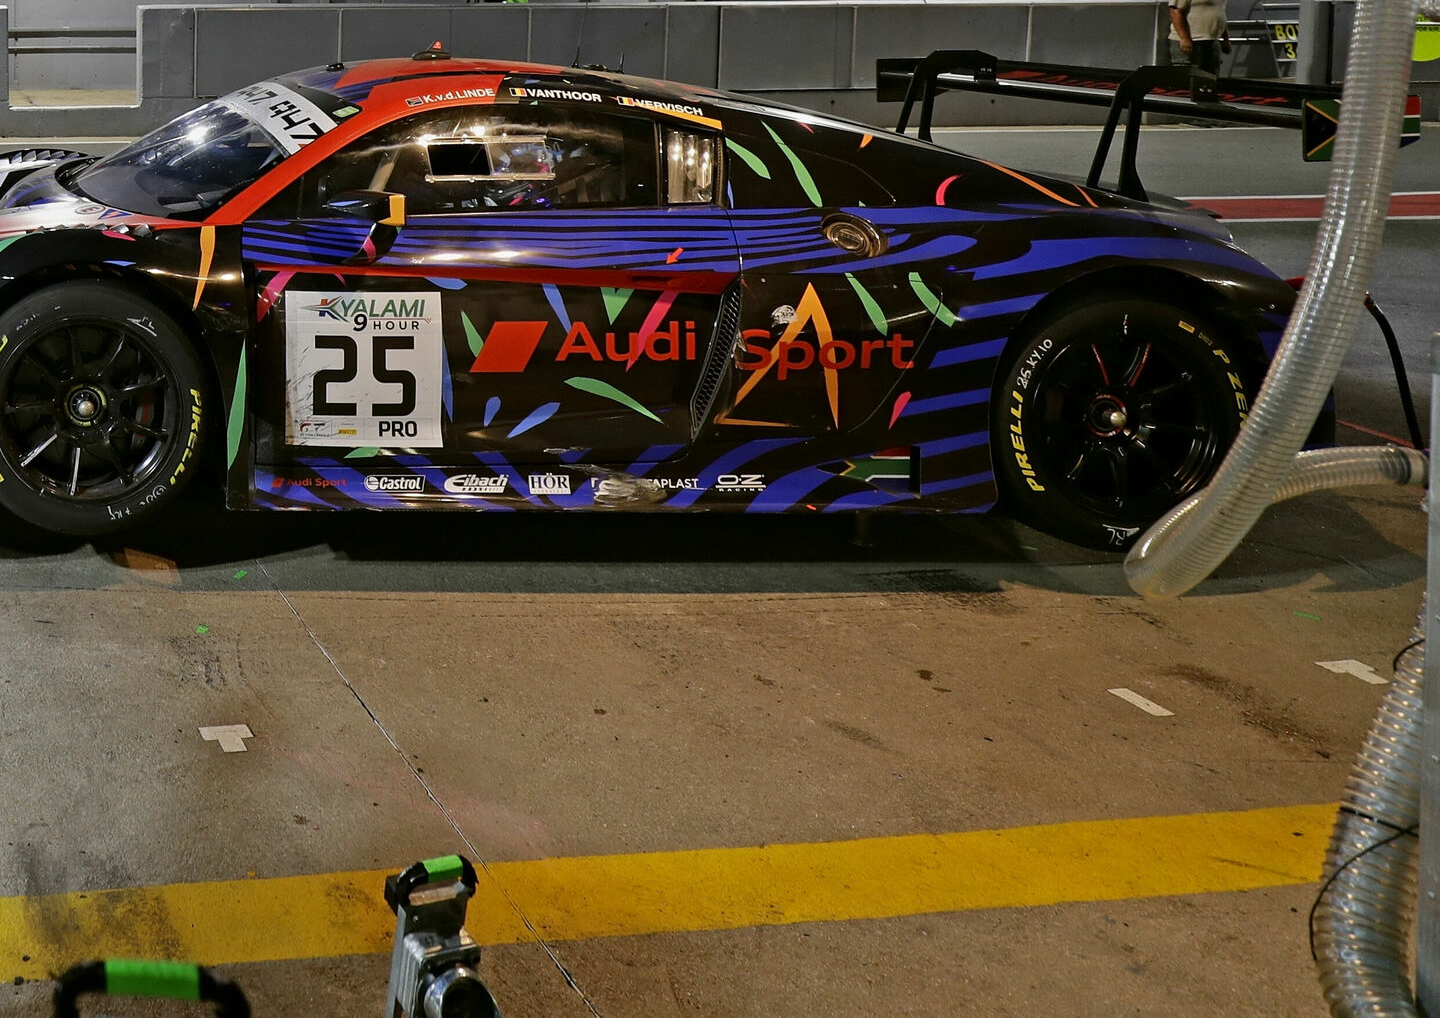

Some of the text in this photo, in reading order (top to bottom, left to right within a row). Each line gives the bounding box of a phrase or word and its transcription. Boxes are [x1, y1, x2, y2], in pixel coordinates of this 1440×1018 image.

[422, 87, 495, 104] K.v.d.LINDE
[526, 88, 602, 103] VANTHOOR
[633, 98, 704, 116] VERVISCH
[318, 295, 426, 323] KYALAMI
[353, 314, 420, 332] 9 HOUR
[555, 320, 915, 381] Audi Sport
[1212, 349, 1231, 364] P
[312, 335, 417, 417] 25
[169, 388, 203, 485] PIRELLI
[378, 420, 418, 437] PRO
[1010, 390, 1046, 492] PIRELLI
[287, 478, 347, 489] Audi Sport
[378, 475, 422, 491] Castrol
[443, 473, 509, 493] Eibach
[530, 472, 570, 489] HÖR
